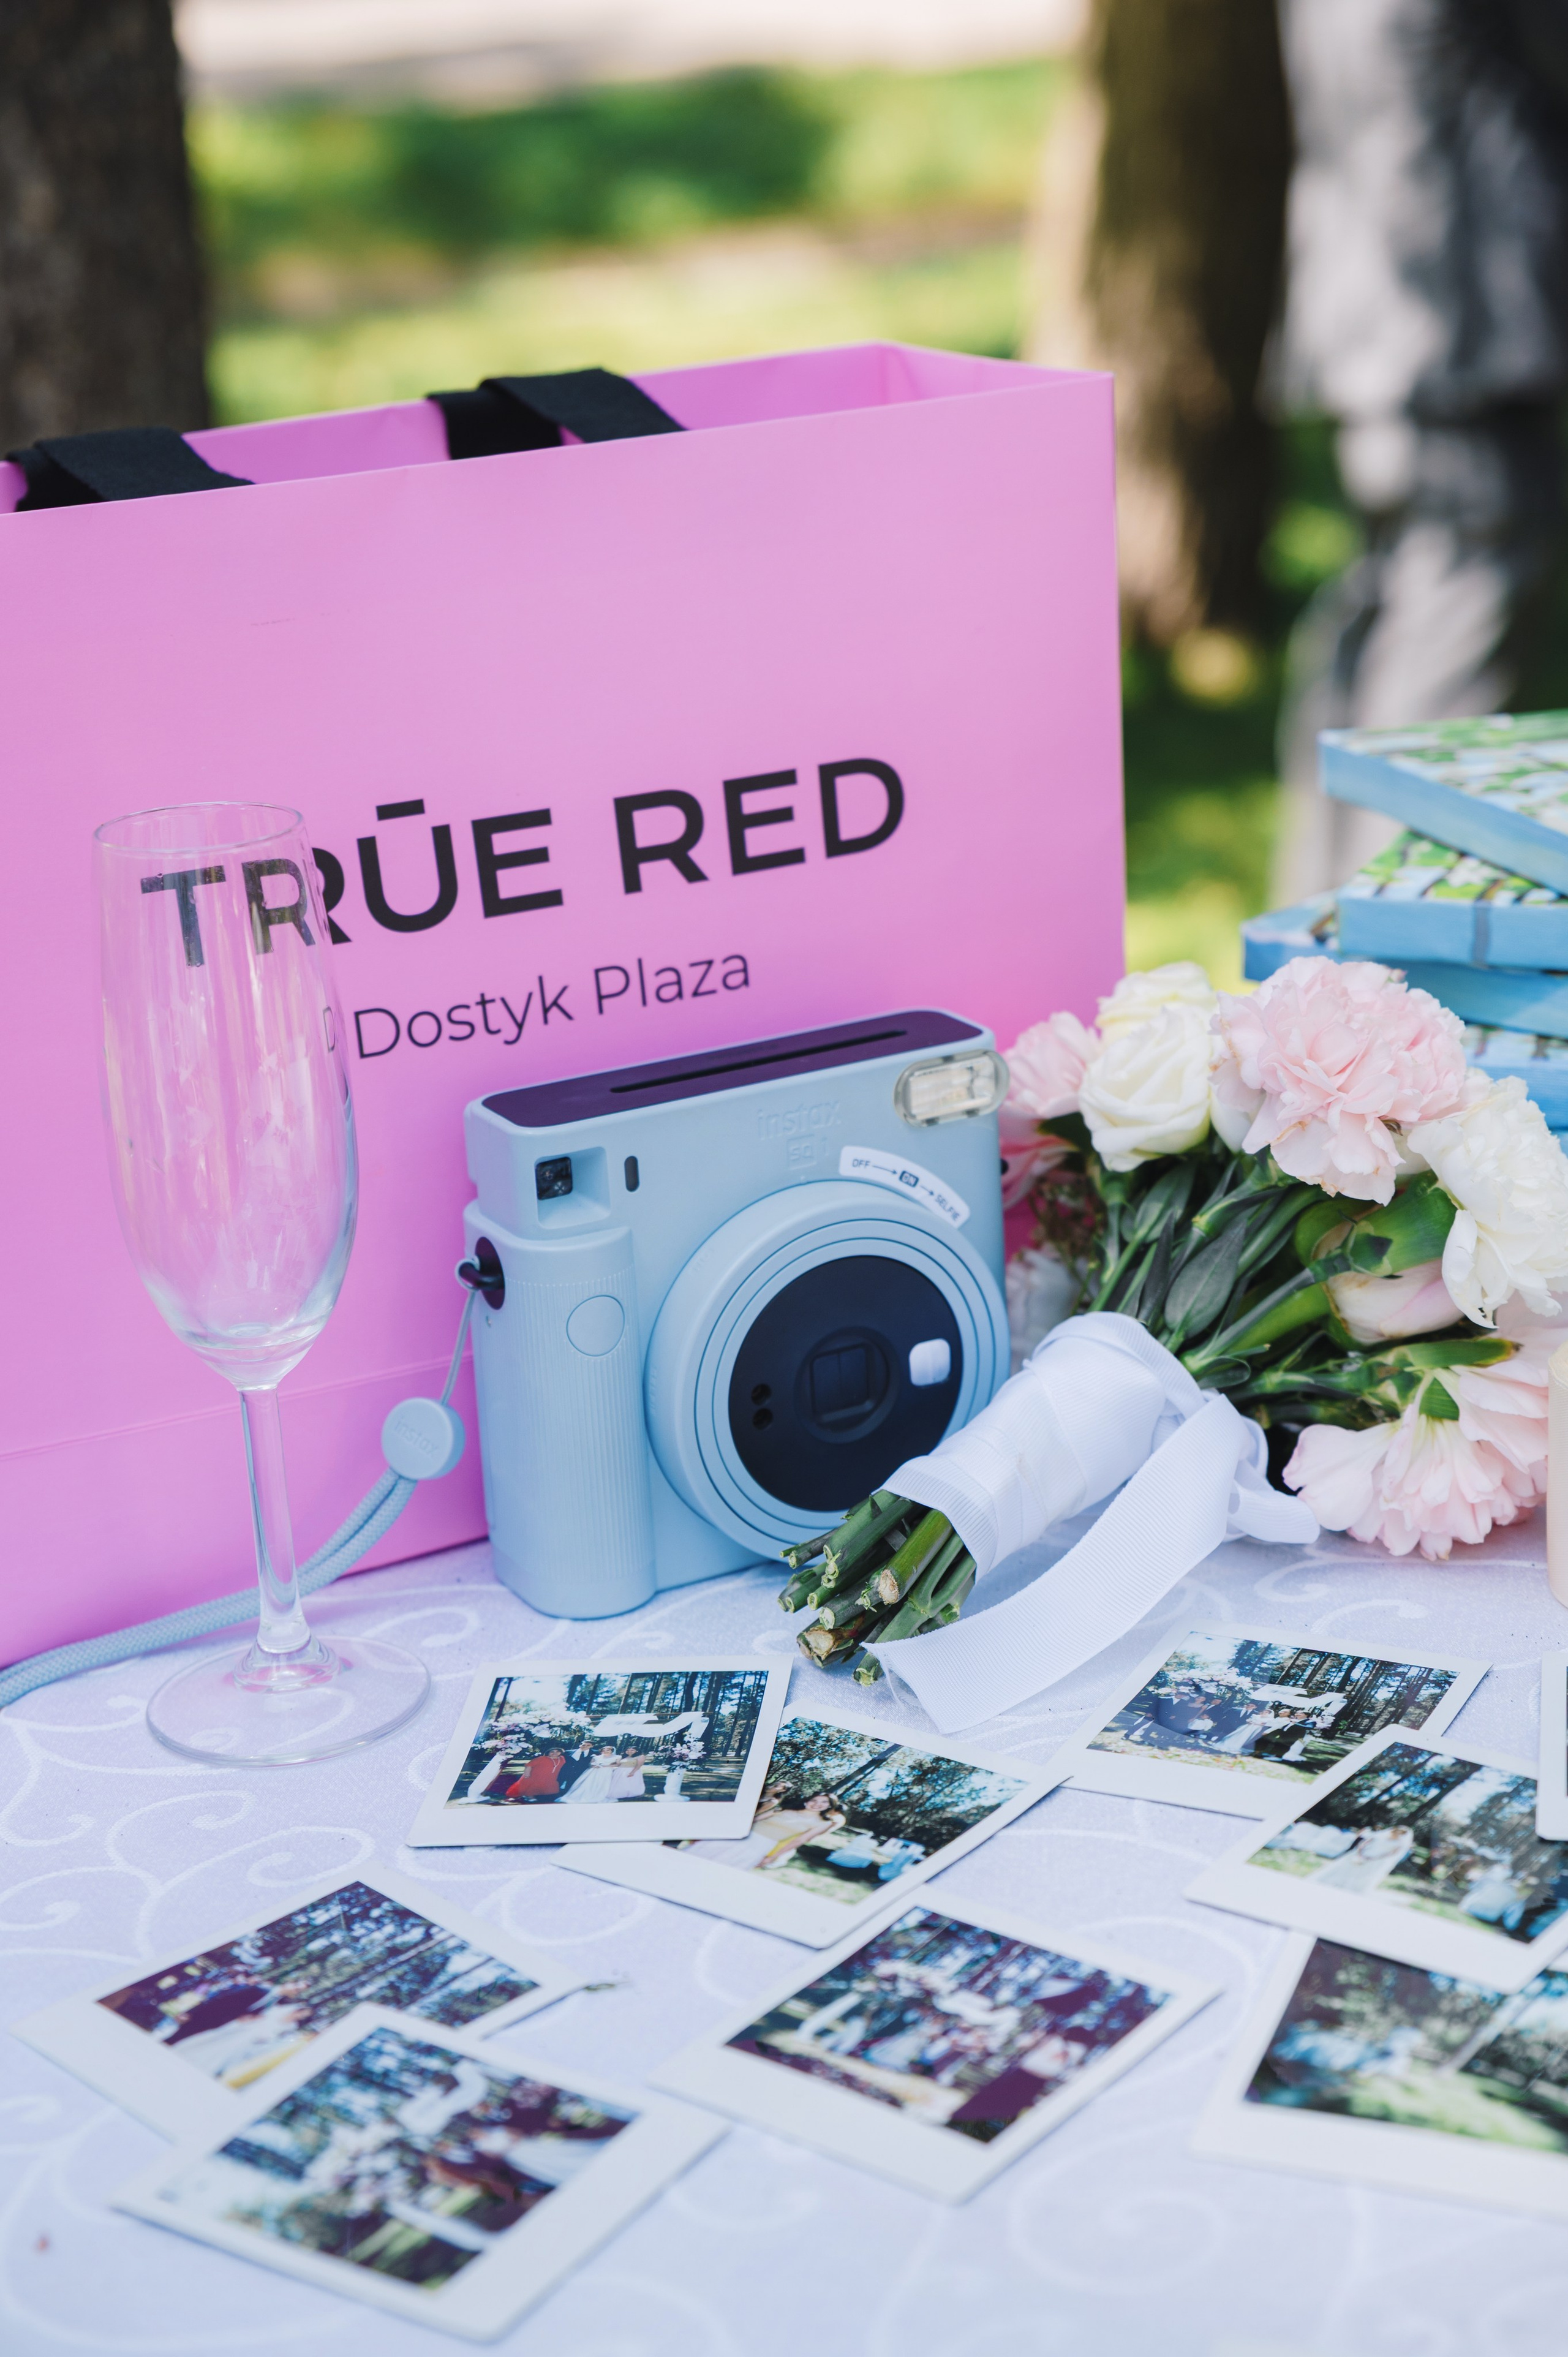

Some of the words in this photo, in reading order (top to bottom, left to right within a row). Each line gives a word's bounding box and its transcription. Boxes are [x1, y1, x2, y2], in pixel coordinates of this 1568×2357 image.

[613, 758, 905, 895] RED
[354, 975, 574, 1059] Dostyk
[593, 954, 751, 1015] Plaza
[757, 1100, 842, 1141] instax
[852, 1159, 871, 1168] OFF
[900, 1171, 918, 1186] ON
[935, 1194, 960, 1221] SELFIE
